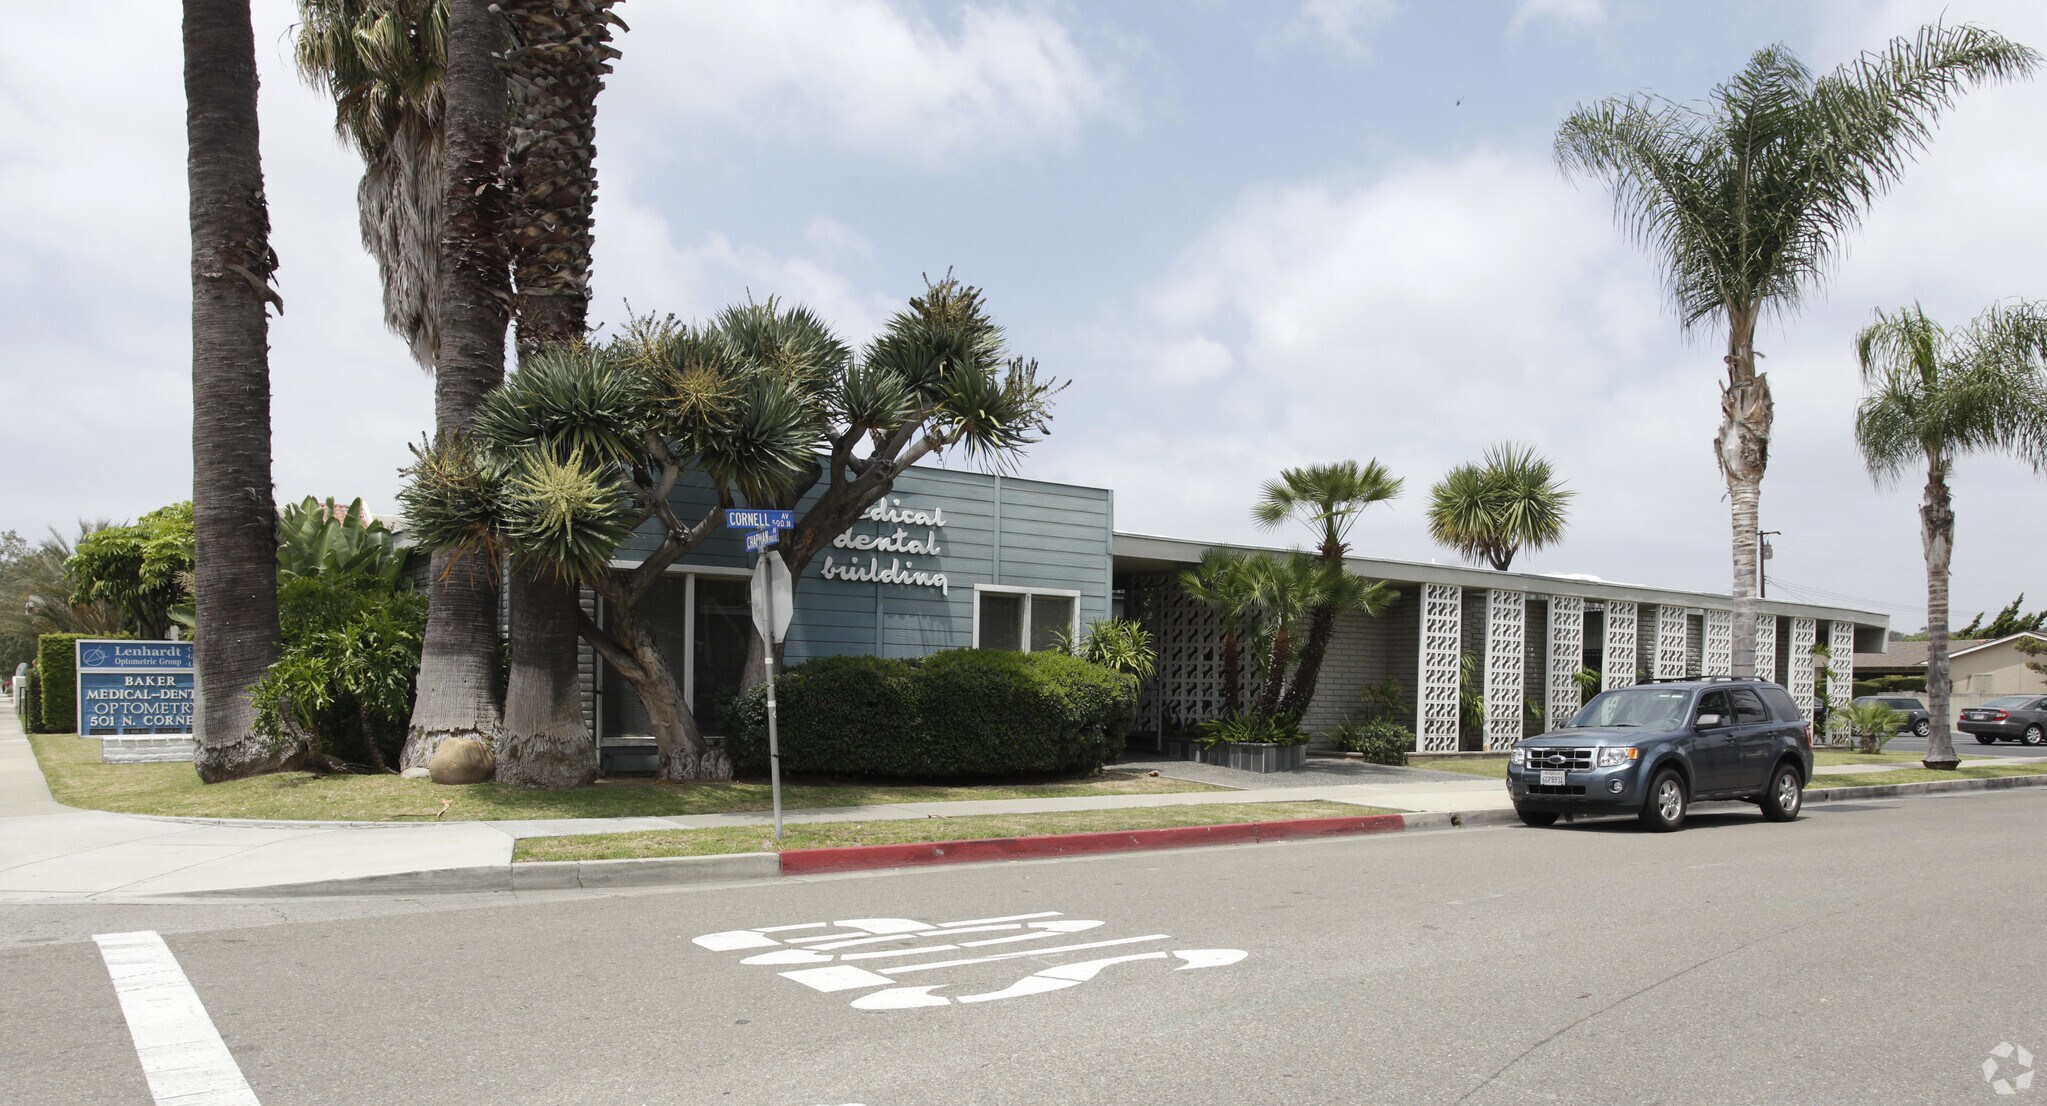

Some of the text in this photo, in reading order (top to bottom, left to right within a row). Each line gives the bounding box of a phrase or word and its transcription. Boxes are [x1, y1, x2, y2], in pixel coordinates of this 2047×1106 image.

[858, 497, 946, 527] dical
[729, 511, 770, 527] CORNELL
[786, 520, 791, 528] N
[833, 527, 941, 556] dental
[821, 555, 948, 596] building
[115, 646, 181, 656] Lenhardt
[115, 658, 182, 667] Optometric Group
[125, 676, 176, 686] BAKER
[87, 689, 194, 699] MEDICAL-DENT
[95, 702, 194, 715] OPTOMETR
[90, 715, 194, 727] 501 N. CORNE
